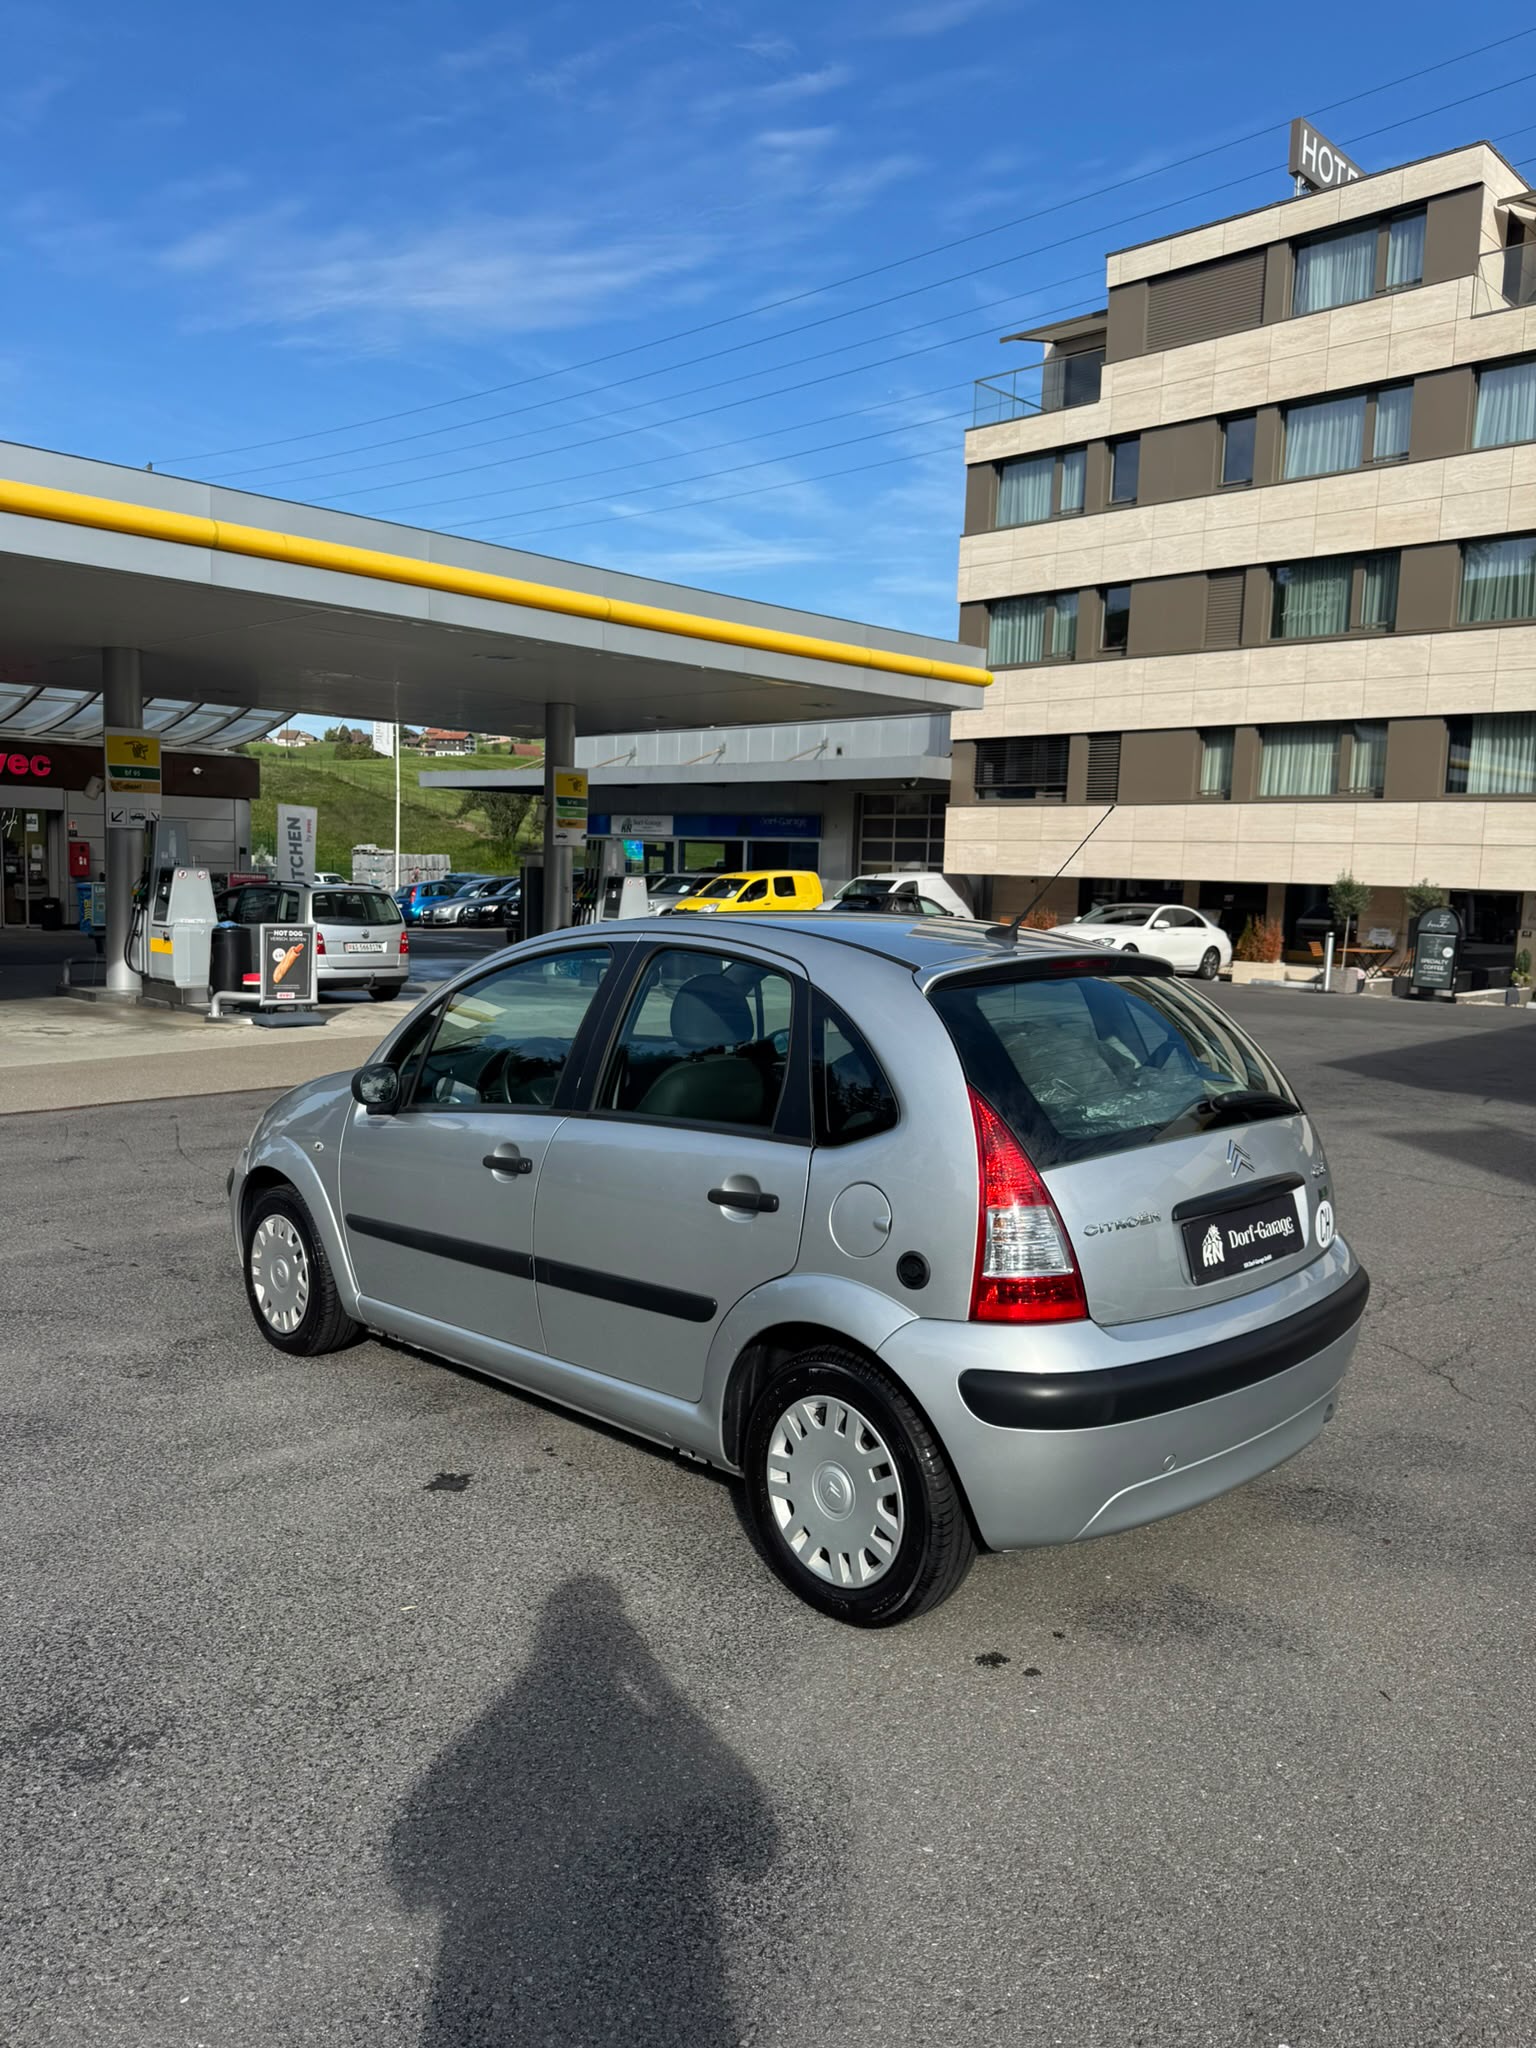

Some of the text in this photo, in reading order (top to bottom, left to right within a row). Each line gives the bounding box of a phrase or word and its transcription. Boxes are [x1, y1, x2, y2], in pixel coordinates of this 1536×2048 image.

[1083, 1211, 1161, 1236] CITROËN
[1227, 1215, 1294, 1249] Dorf-Garage
[1320, 1206, 1331, 1242] CH
